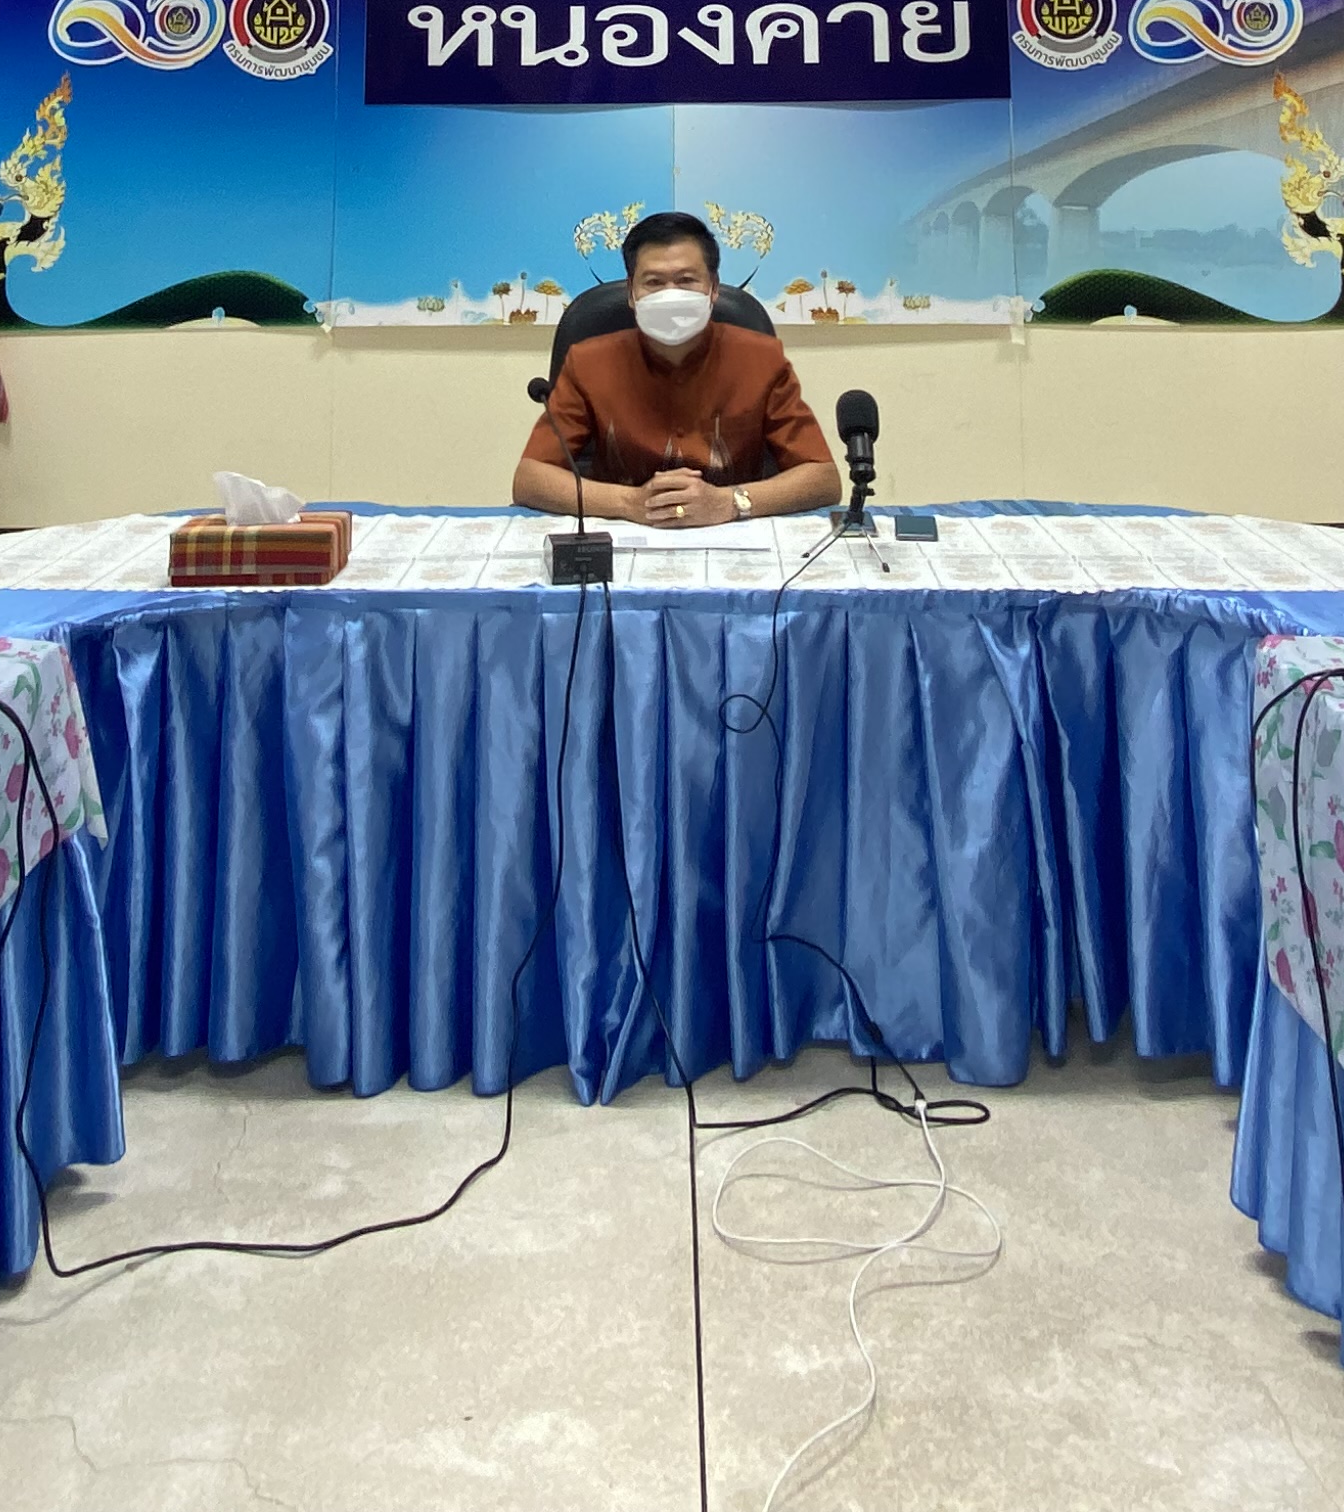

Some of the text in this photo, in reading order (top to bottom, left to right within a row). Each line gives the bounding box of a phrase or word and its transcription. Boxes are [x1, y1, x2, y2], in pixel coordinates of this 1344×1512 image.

[406, 0, 972, 67] หนองคาย
[1014, 32, 1122, 68] กรมการพัฒนาชุมชน
[225, 42, 331, 78] กรมการพัฒนาชุมชน
